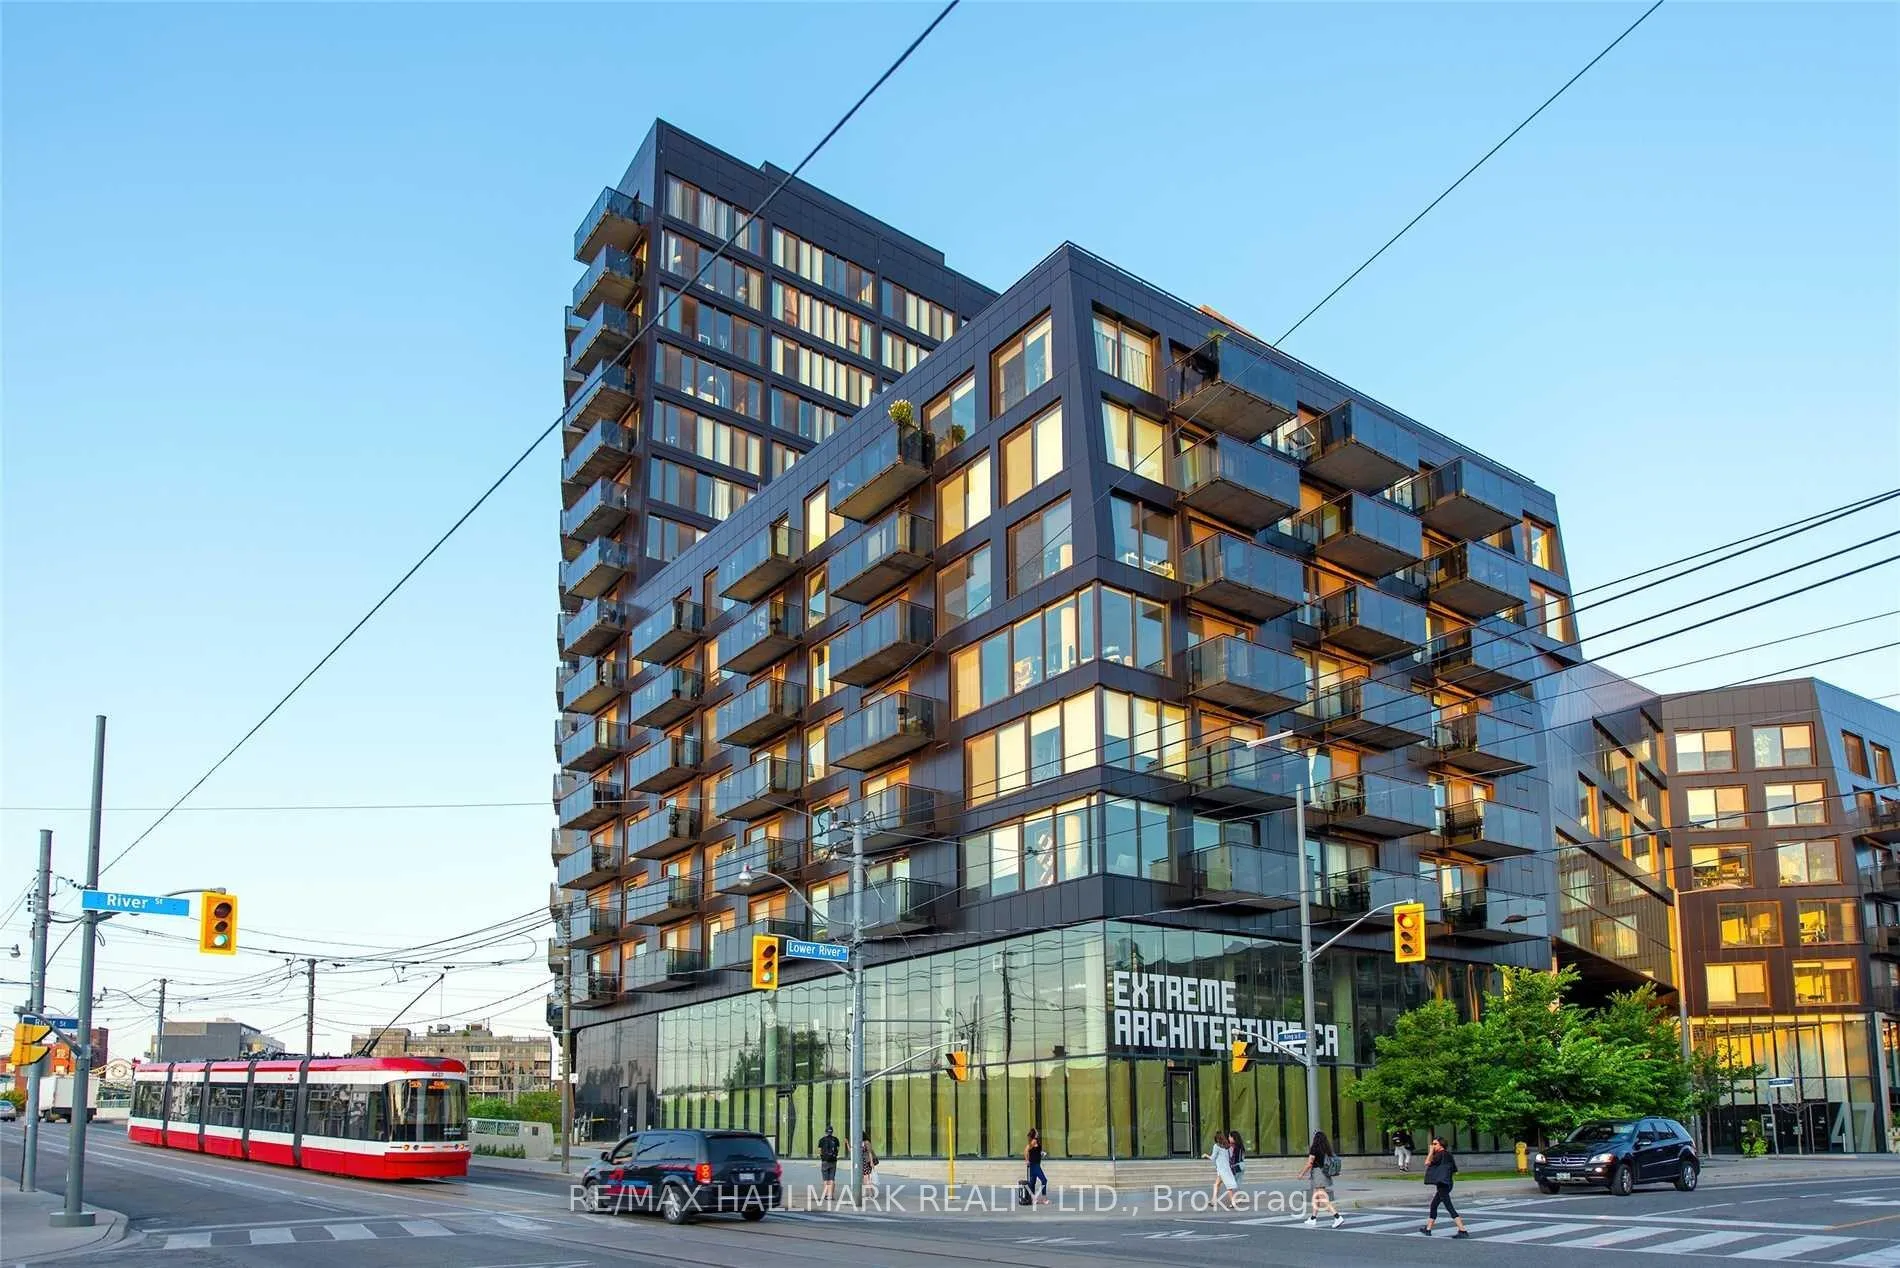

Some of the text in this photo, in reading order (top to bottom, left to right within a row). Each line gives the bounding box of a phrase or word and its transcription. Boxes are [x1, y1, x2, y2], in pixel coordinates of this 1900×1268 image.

[106, 893, 149, 909] River
[789, 941, 816, 954] Lower
[819, 944, 841, 957] River
[1113, 970, 1237, 1015] EXTREME
[35, 1018, 56, 1028] Rir
[1831, 1102, 1874, 1152] 47
